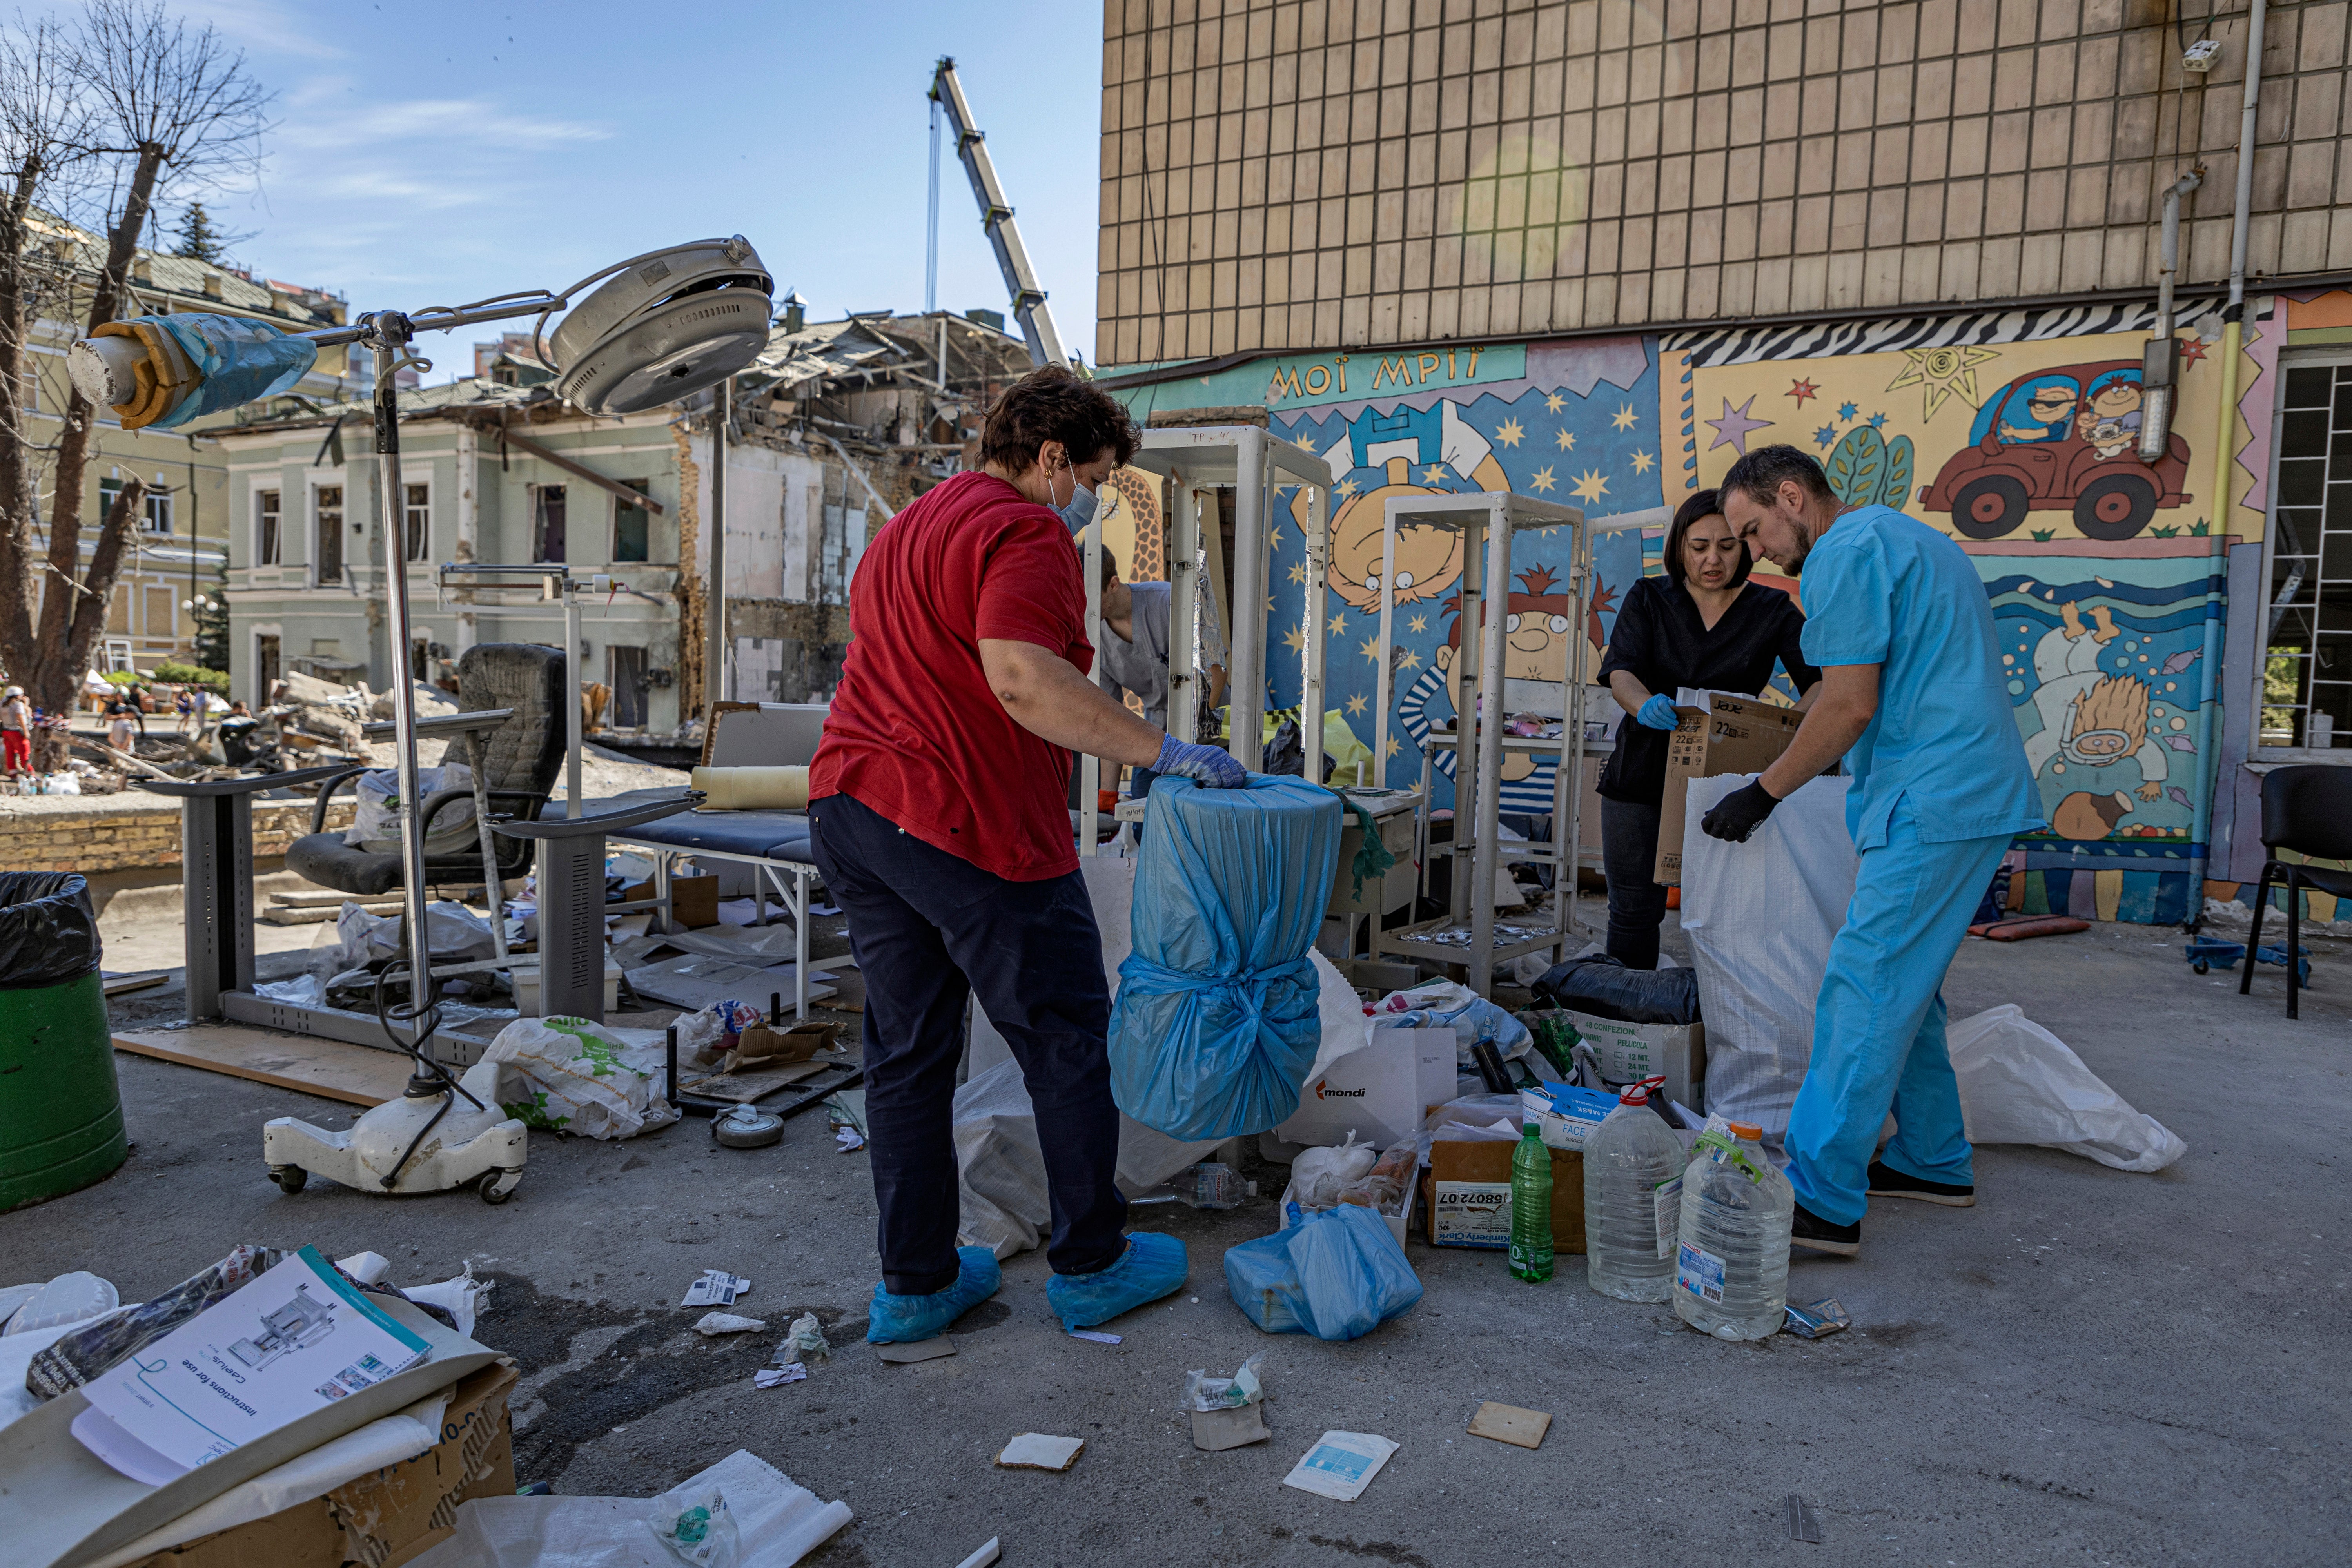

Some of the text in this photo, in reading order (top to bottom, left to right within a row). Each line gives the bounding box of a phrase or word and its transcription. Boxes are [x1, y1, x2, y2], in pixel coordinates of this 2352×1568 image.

[1271, 346, 1484, 399] МОЇ МРІЇ
[1714, 700, 1743, 714] acer
[1716, 721, 1729, 735] 22
[1617, 1039, 1647, 1049] PELLICOLA
[603, 1083, 617, 1092] КОЛІ
[1324, 1087, 1365, 1098] mondi
[1526, 1109, 1537, 1118] MASK
[1577, 1106, 1600, 1116] MASK
[1563, 1124, 1586, 1137] FACE
[1439, 1194, 1457, 1203] 07
[1461, 1194, 1502, 1203] 58072
[1439, 1232, 1510, 1243] Kimberly-Clark
[51, 1345, 62, 1357] Вы
[45, 1363, 69, 1388] (0482)
[212, 1356, 246, 1384] Caelus
[182, 1358, 257, 1416] Instructions for use
[136, 1393, 152, 1406] smart
[1301, 1467, 1345, 1480] DAHLHAUSEN
[1334, 1469, 1356, 1478] MANUS
